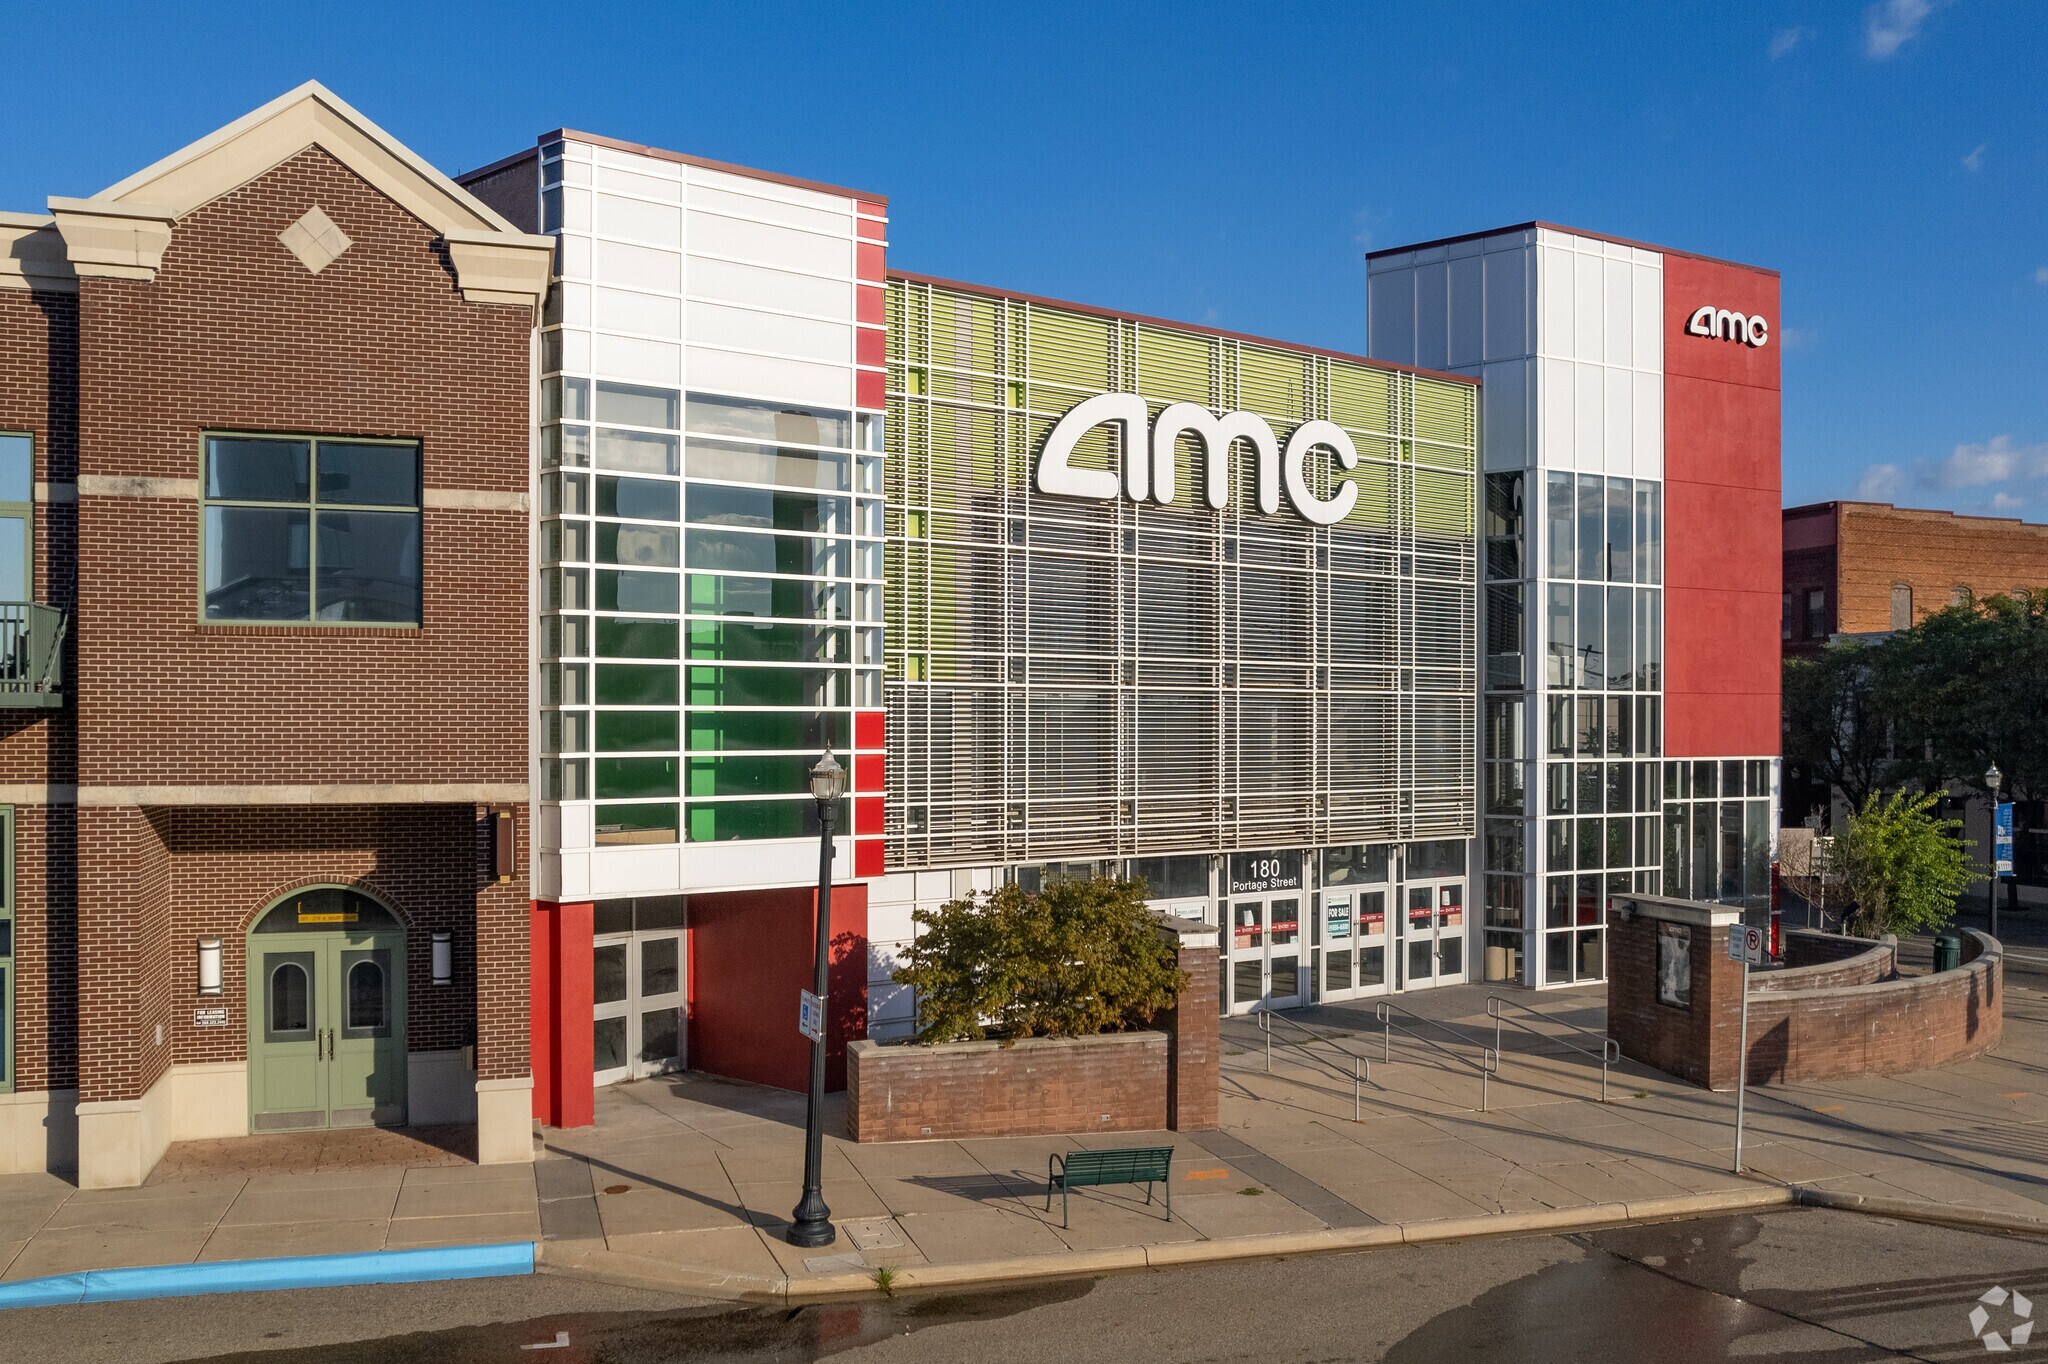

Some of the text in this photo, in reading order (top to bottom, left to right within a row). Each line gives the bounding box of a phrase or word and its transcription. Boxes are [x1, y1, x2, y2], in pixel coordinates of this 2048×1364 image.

[1688, 305, 1768, 347] amc
[1035, 391, 1359, 525] amc
[1250, 859, 1280, 878] 180
[1232, 876, 1297, 891] Portage Street
[1328, 906, 1349, 918] FOR SALE
